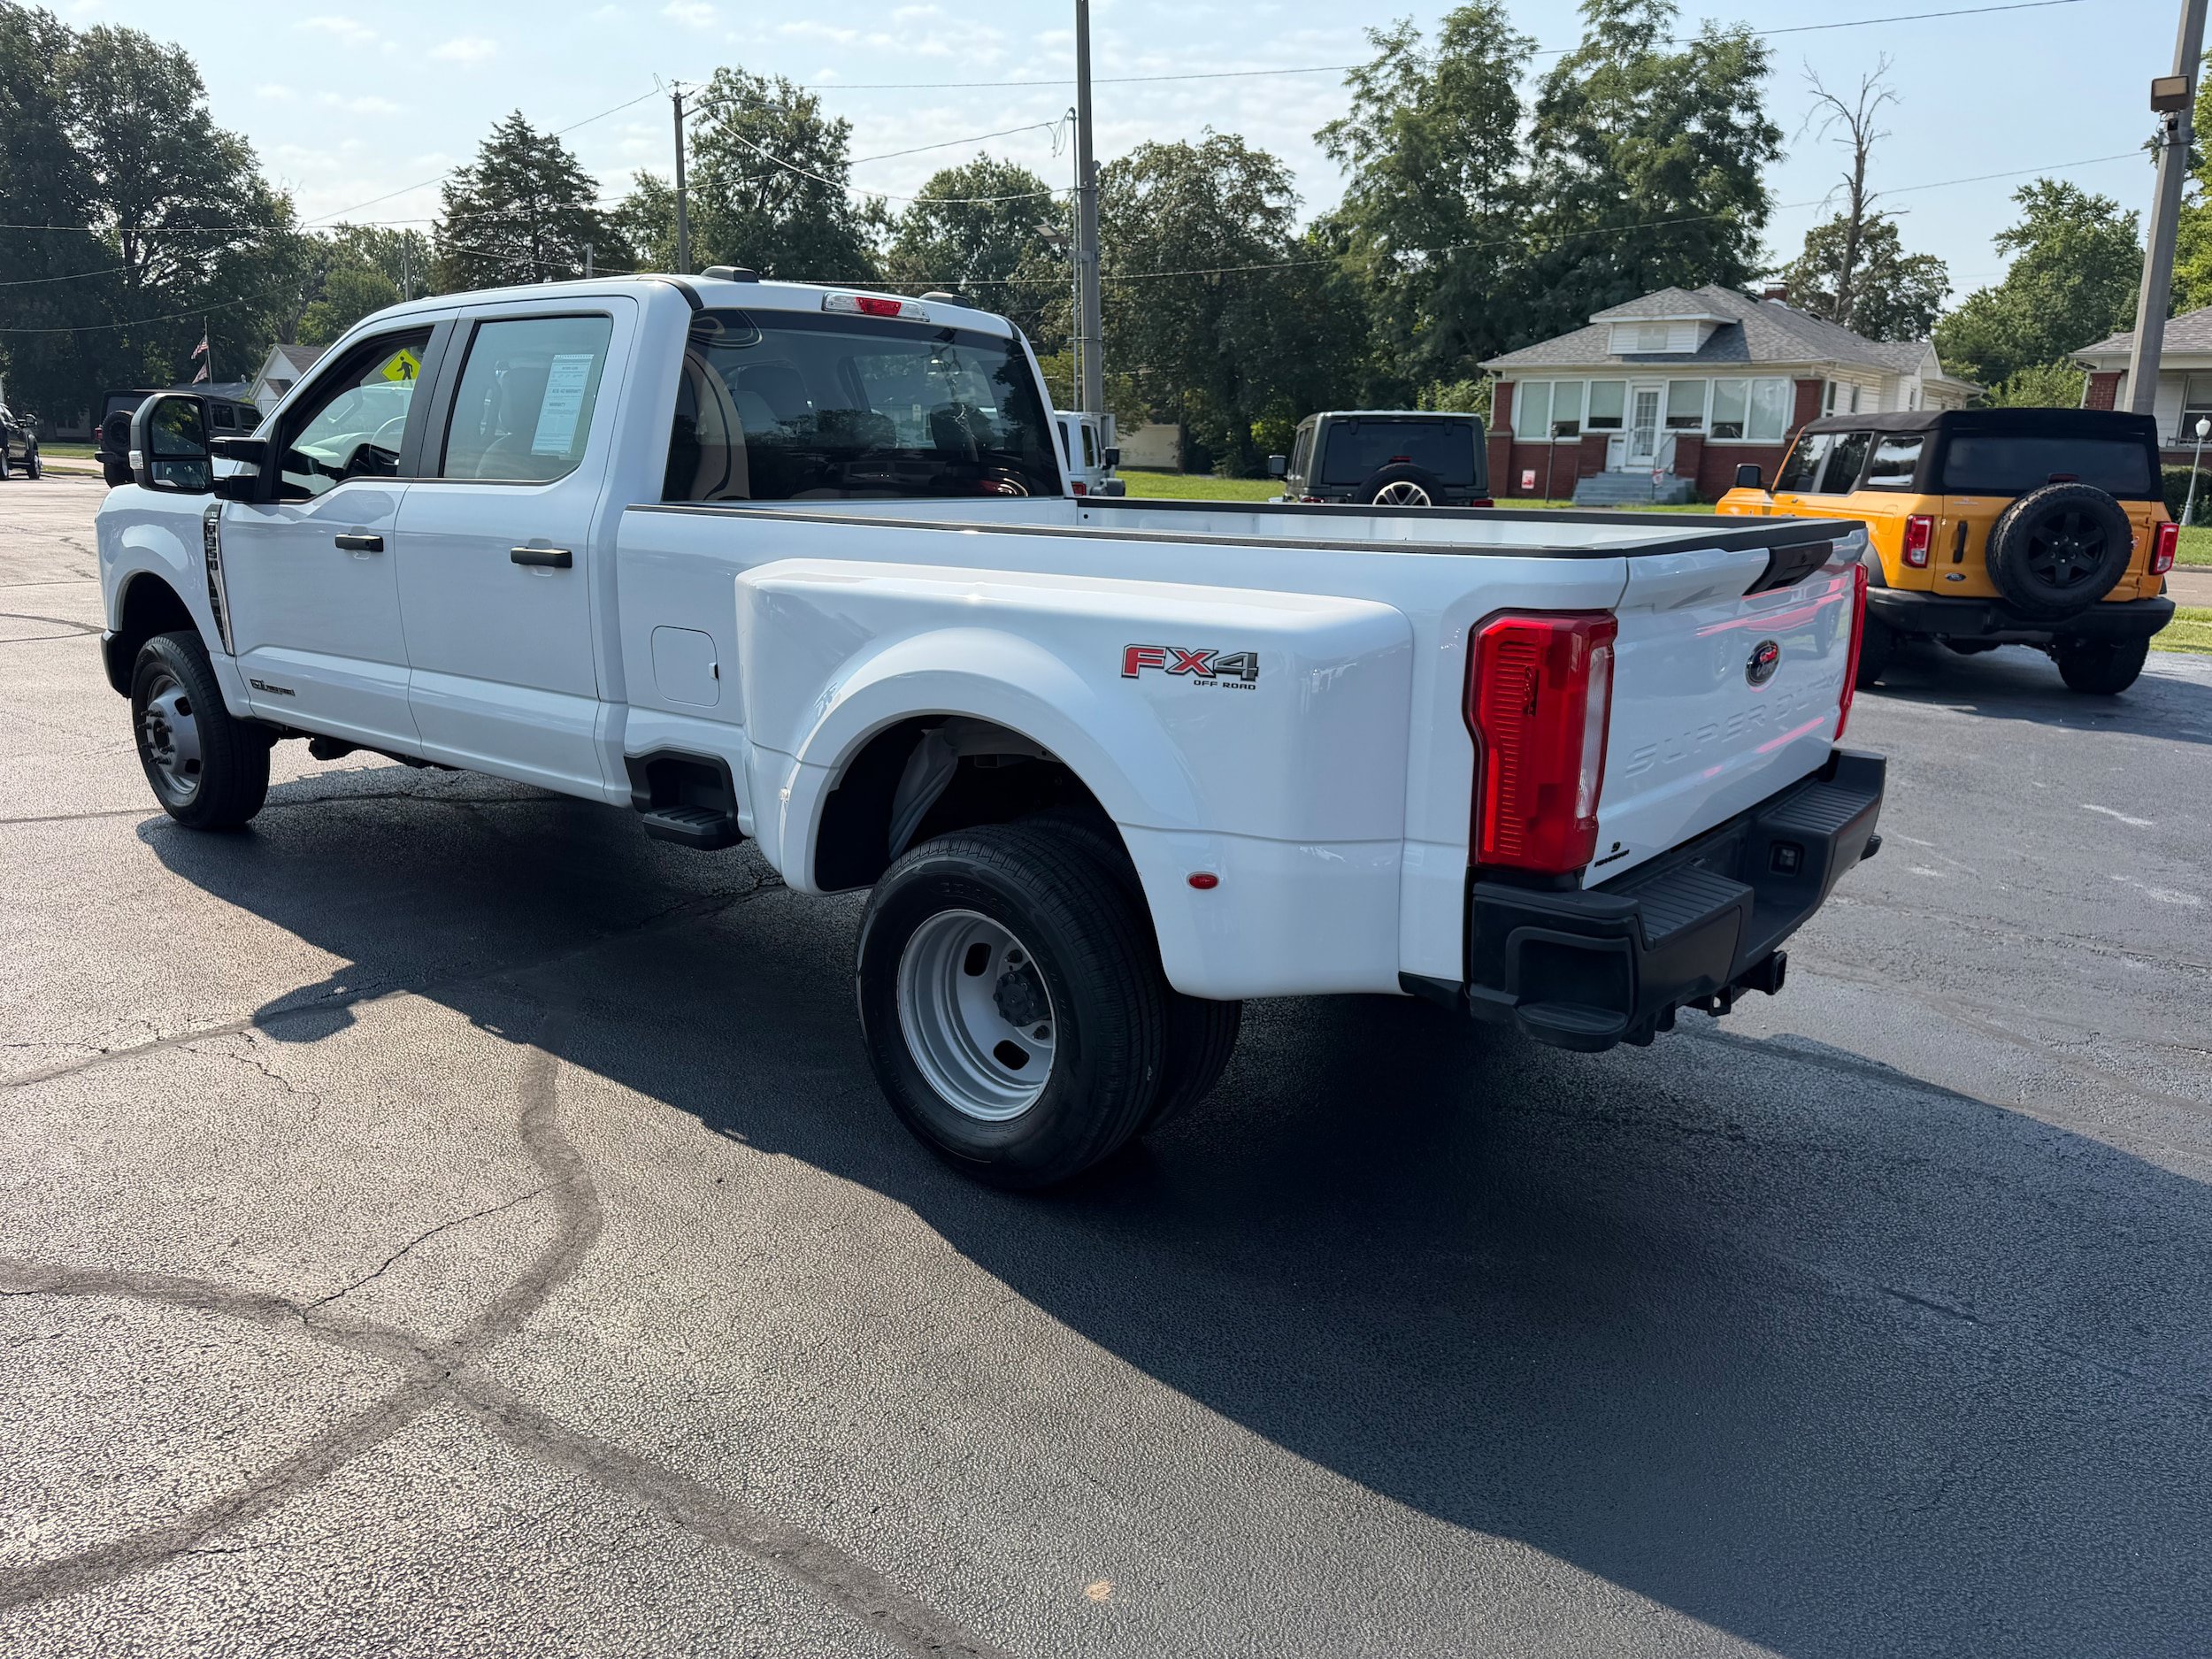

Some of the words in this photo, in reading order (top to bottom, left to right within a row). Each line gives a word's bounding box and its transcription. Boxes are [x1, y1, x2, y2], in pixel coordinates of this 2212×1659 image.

[1121, 643, 1259, 682] FX4
[1222, 681, 1256, 691] ROAD
[1624, 703, 1768, 779] SUPER
